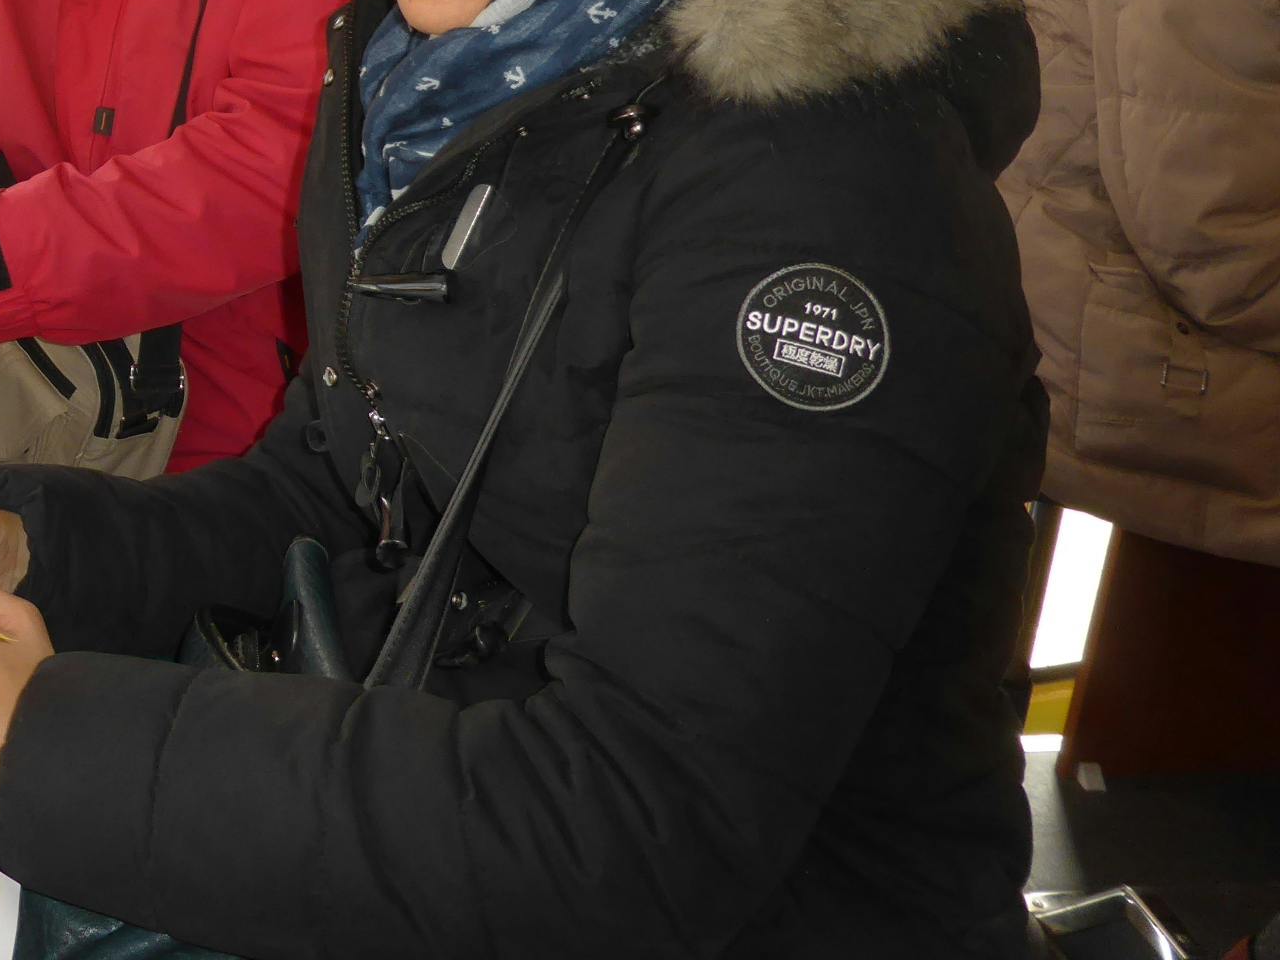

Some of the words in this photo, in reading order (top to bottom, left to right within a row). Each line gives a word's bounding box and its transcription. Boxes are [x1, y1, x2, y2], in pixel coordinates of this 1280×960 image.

[763, 276, 849, 309] ORIGINAL
[849, 302, 875, 331] JPN
[804, 302, 838, 321] 1971
[746, 311, 882, 361] SUPERDRY
